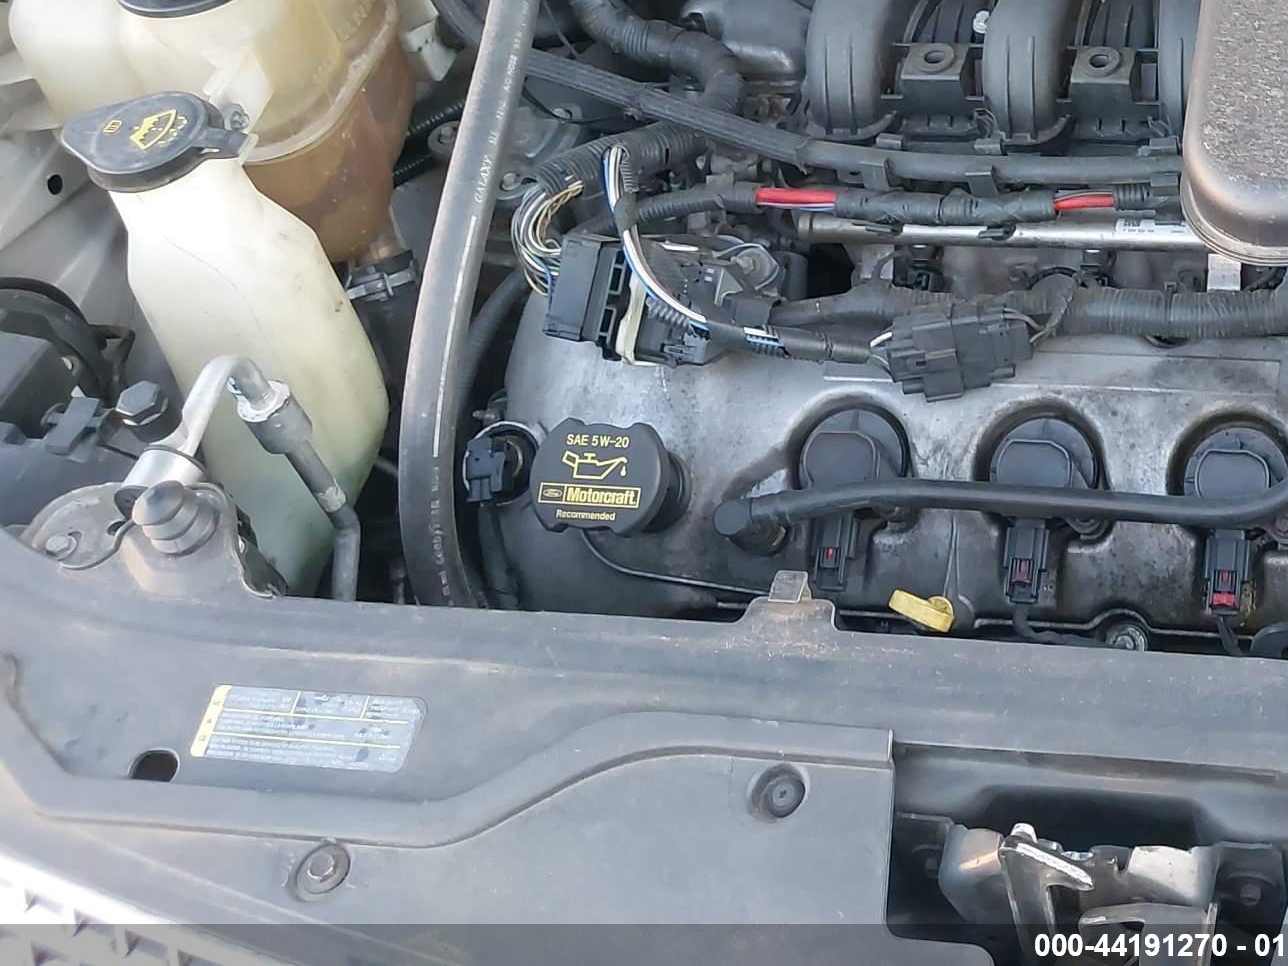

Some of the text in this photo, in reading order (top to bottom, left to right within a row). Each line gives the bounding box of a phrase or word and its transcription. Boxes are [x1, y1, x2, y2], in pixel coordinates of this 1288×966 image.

[474, 155, 493, 203] GALAXY
[566, 434, 630, 449] SAE 5W-20
[566, 487, 636, 505] Motorcraft
[556, 509, 616, 521] Recommended
